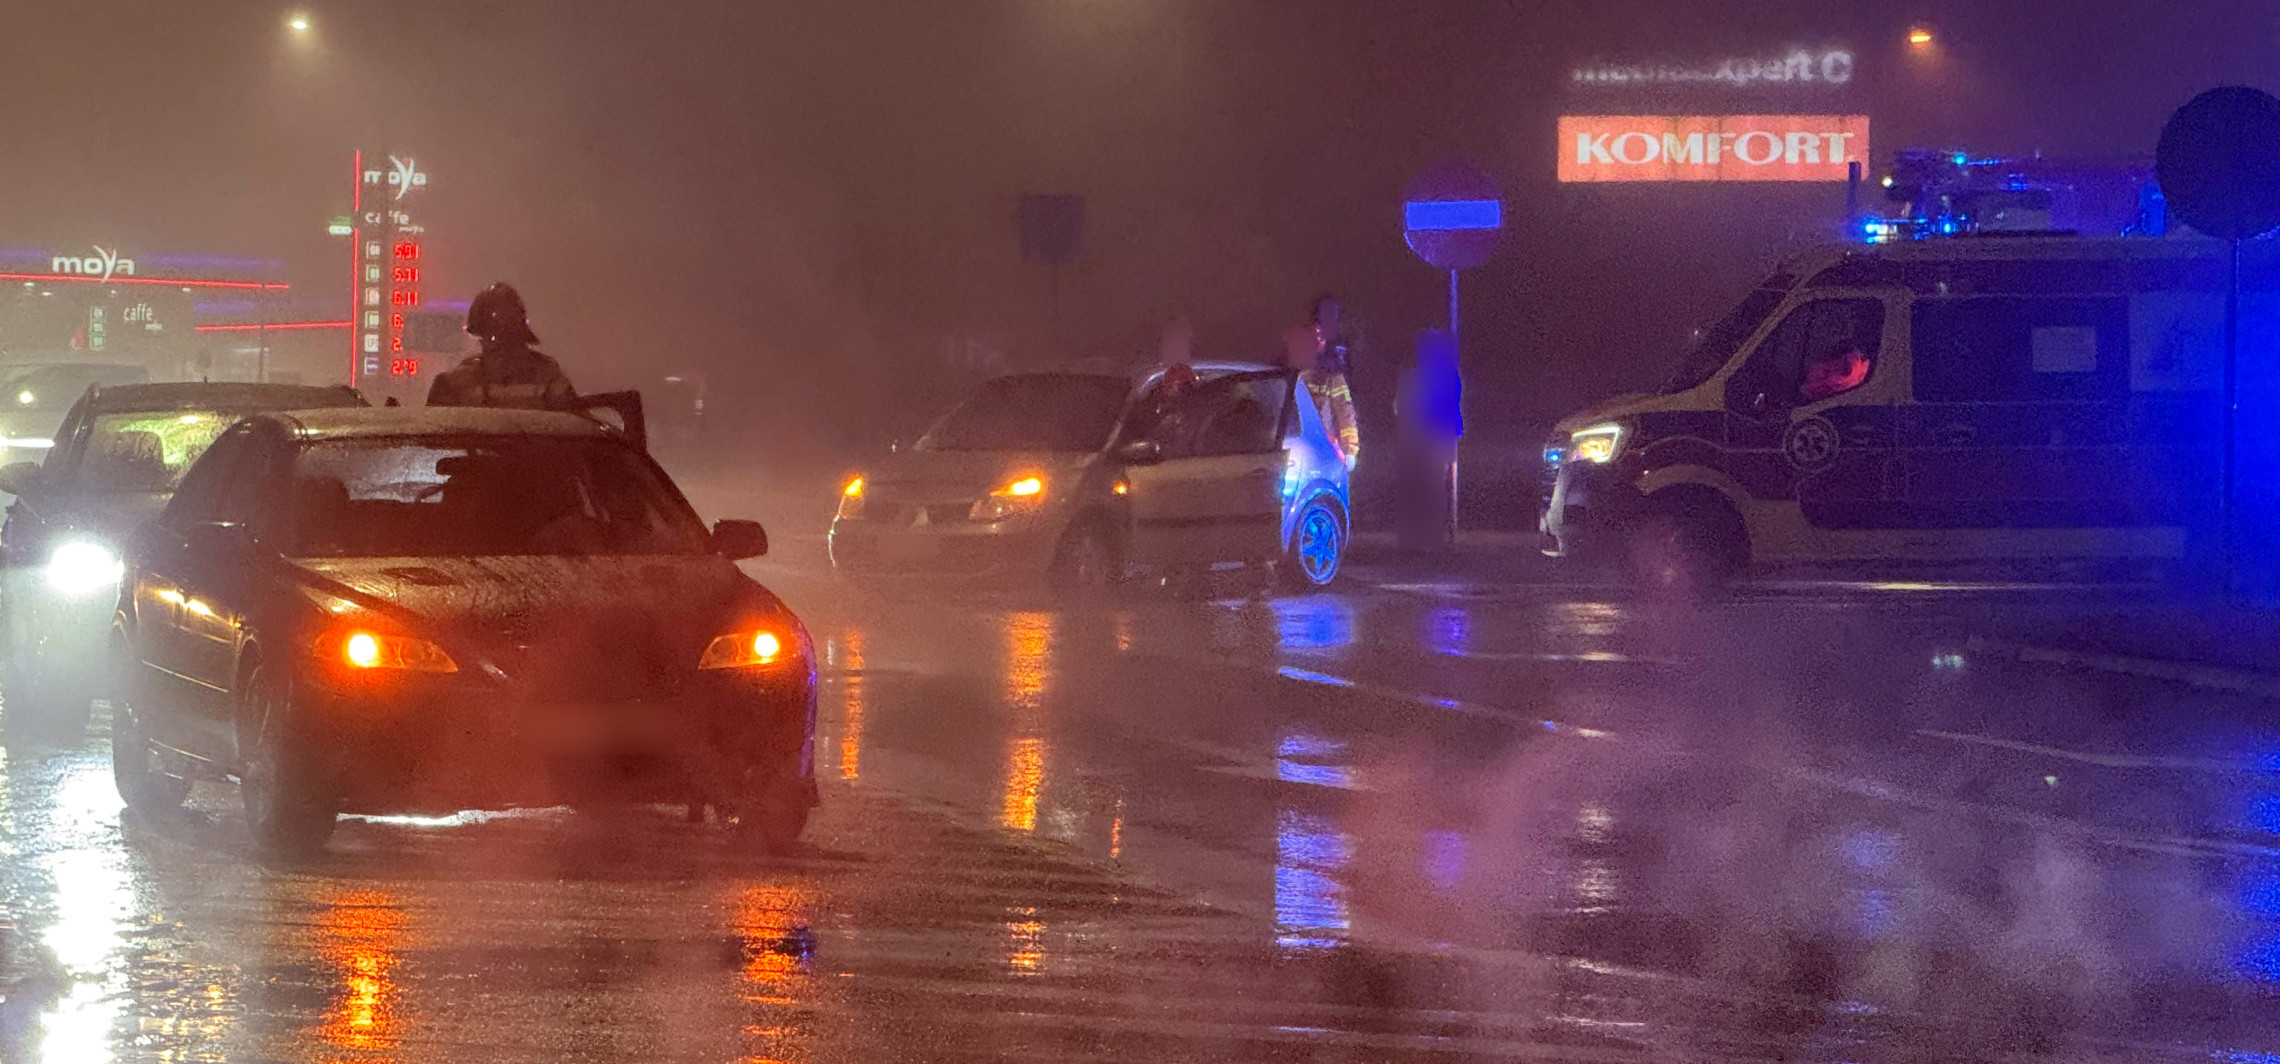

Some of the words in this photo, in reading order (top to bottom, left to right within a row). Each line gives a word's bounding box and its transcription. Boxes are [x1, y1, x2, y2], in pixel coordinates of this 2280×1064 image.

[365, 210, 410, 225] cafe
[52, 245, 135, 284] moya
[124, 302, 152, 321] caffe
